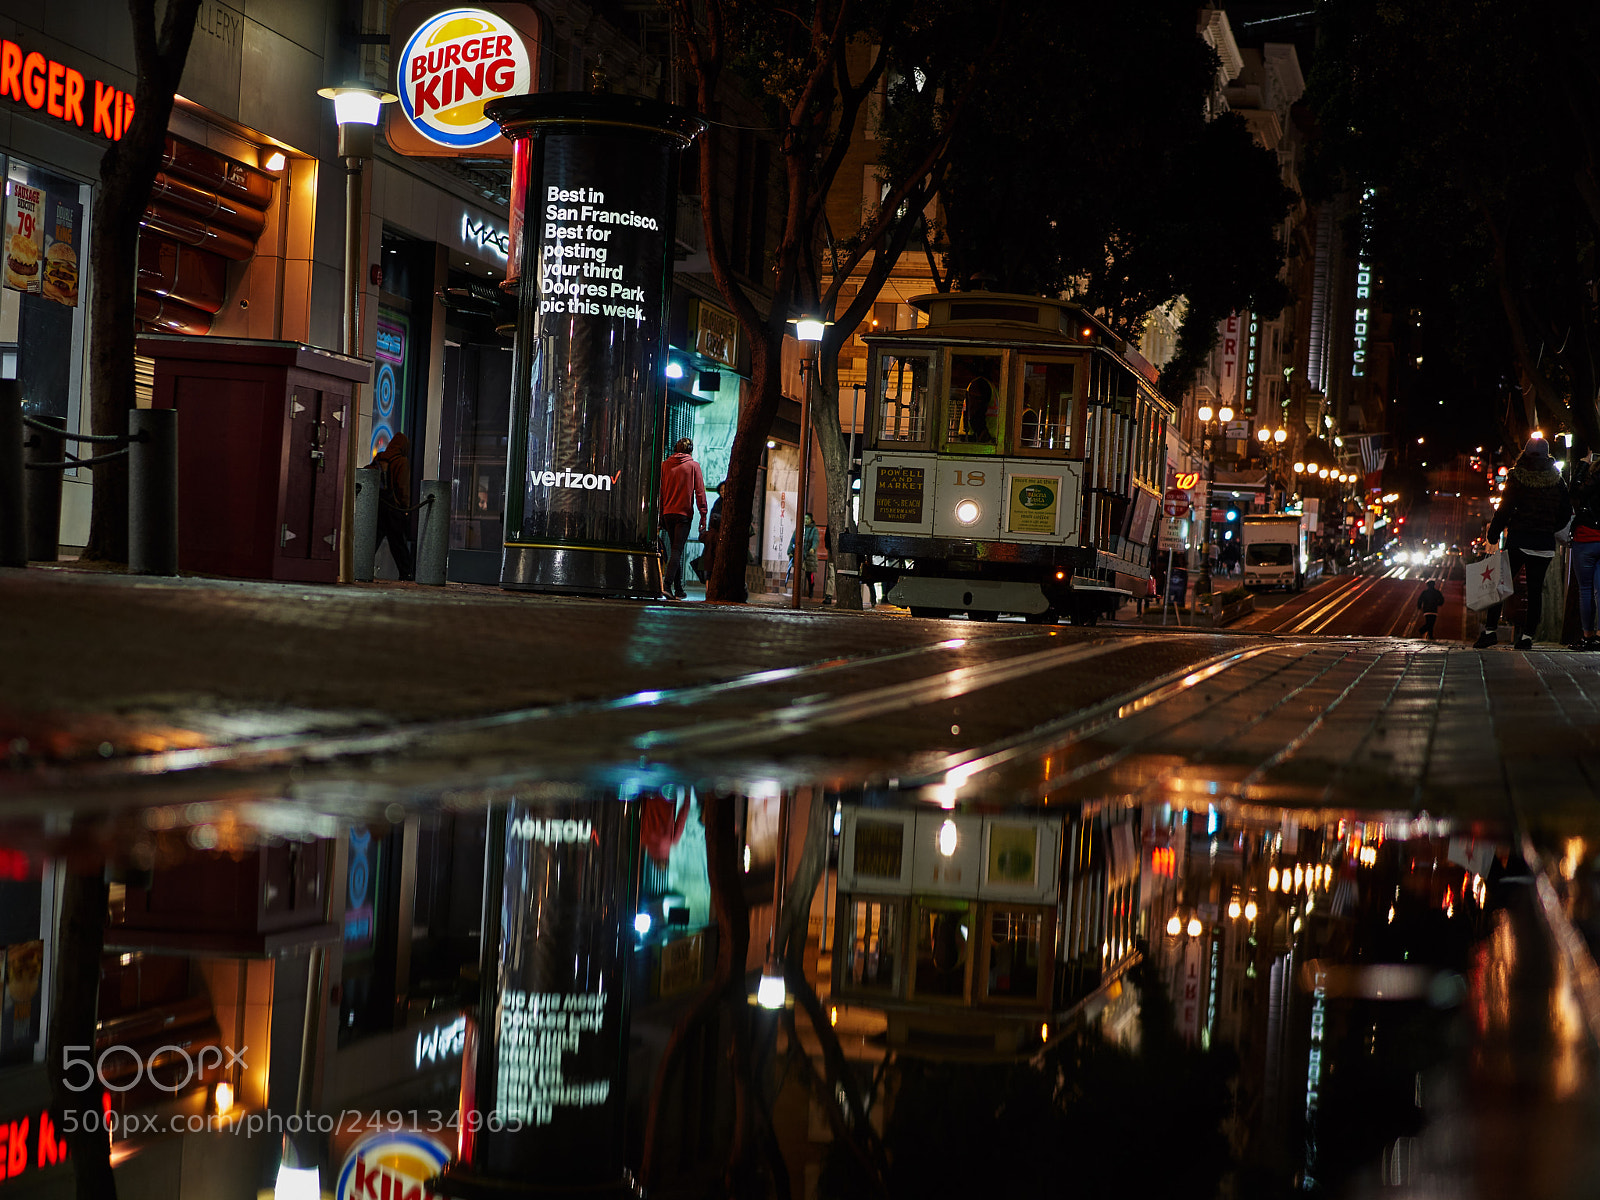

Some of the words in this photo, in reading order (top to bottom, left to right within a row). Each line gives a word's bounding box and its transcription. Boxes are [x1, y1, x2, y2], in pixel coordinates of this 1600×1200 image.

[197, 1, 240, 46] LLERY
[411, 35, 513, 83] BURGER
[0, 38, 85, 127] RGER
[415, 58, 516, 118] KING
[15, 184, 40, 205] SAUSAGE
[547, 186, 585, 202] Best
[588, 187, 604, 204] in
[545, 205, 578, 221] San
[581, 205, 659, 231] Francisco.
[545, 223, 583, 239] Best
[586, 225, 611, 241] for
[543, 243, 607, 262] posting
[543, 263, 580, 278] your
[583, 262, 623, 280] third
[541, 279, 608, 297] Dolores
[610, 282, 645, 302] Park
[540, 297, 565, 315] pic
[568, 298, 600, 315] this
[602, 304, 646, 321] week.
[1225, 308, 1237, 378] ERT
[1351, 308, 1369, 378] HOTEL
[1247, 310, 1258, 401] LORENCE
[530, 467, 612, 491] verizon
[879, 481, 924, 490] MARKET
[880, 469, 923, 478] POWELL
[953, 470, 986, 486] 18
